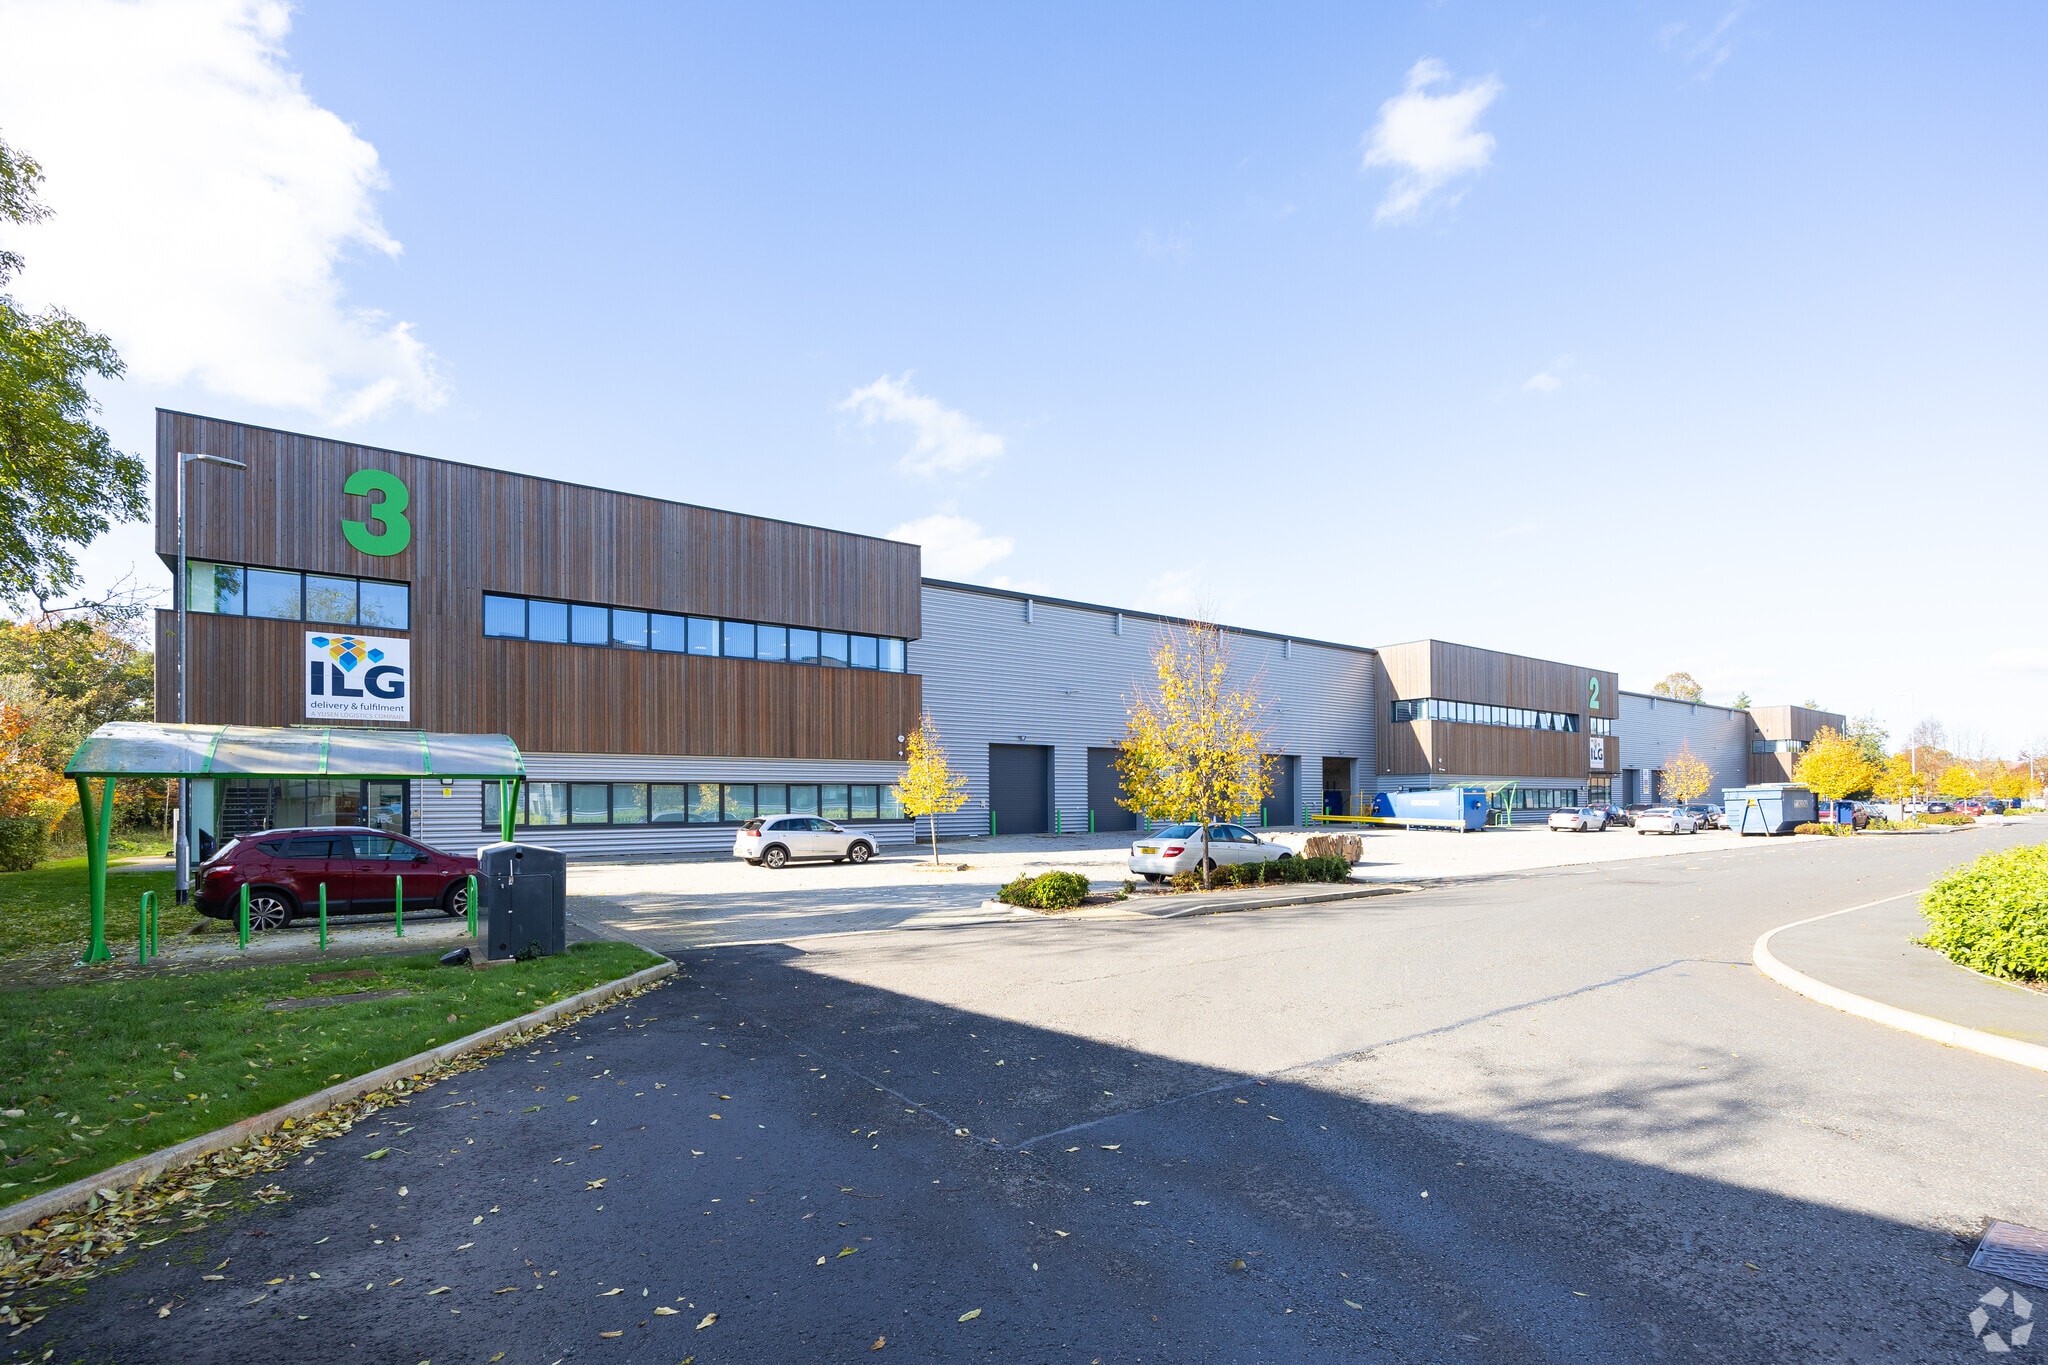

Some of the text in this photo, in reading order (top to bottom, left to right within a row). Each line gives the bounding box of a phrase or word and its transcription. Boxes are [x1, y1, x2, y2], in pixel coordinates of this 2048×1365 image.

[341, 469, 411, 557] 3
[310, 660, 404, 699] ILG
[1589, 676, 1600, 710] 2
[310, 701, 348, 711] delivery
[360, 703, 404, 712] fulfilment
[1590, 748, 1602, 760] ILG
